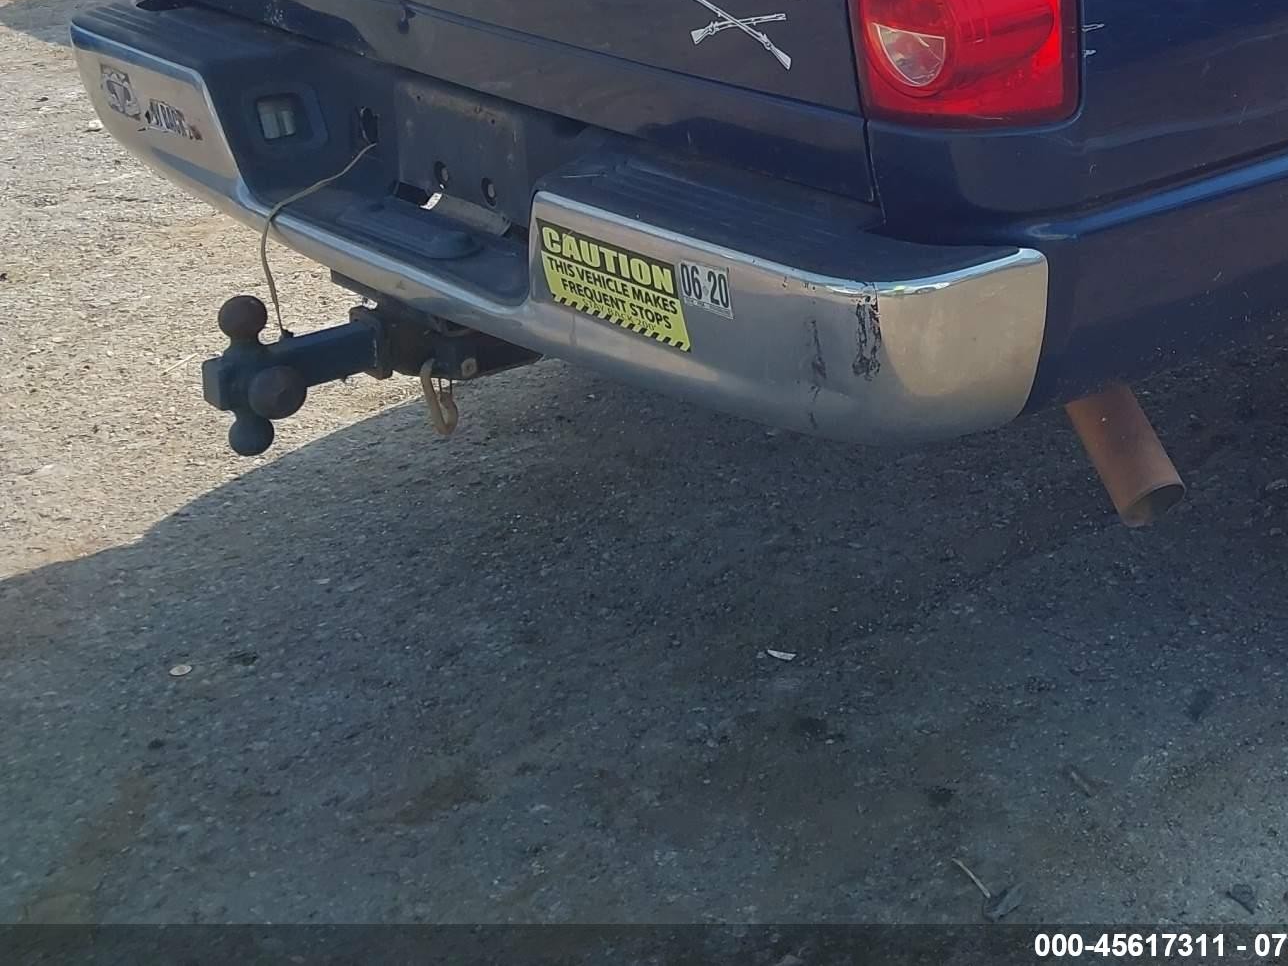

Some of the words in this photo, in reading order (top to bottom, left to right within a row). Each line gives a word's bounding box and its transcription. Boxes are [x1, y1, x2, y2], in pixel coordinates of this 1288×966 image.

[542, 226, 674, 294] CAUTION
[547, 255, 575, 278] THIS
[576, 267, 630, 297] VEHICLE
[632, 286, 678, 315] MAKES
[680, 263, 703, 300] 06
[707, 270, 729, 309] 20
[560, 278, 626, 313] FREQUENT
[629, 302, 672, 330] STOPS
